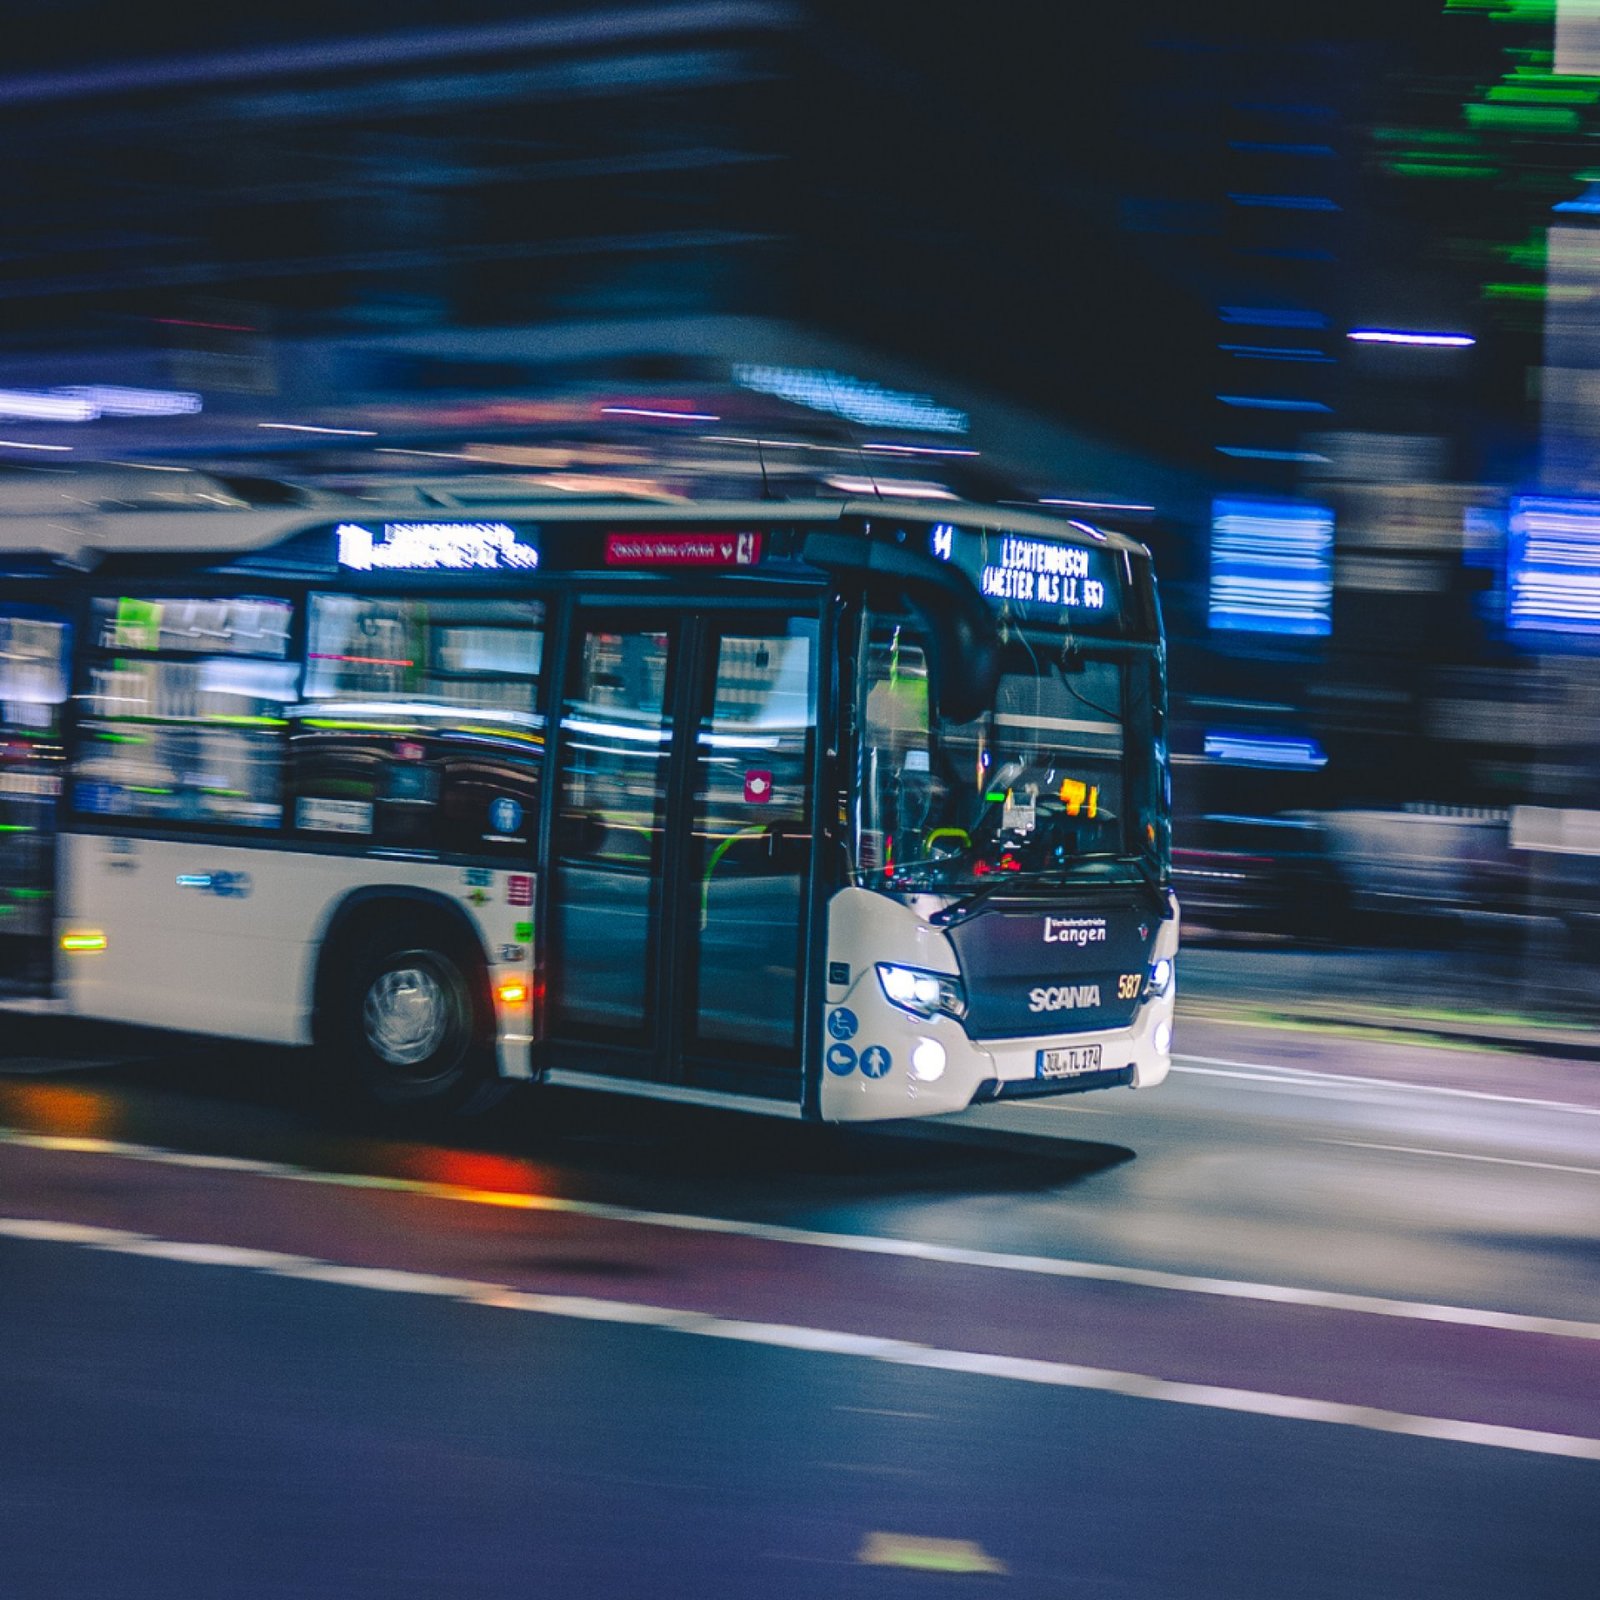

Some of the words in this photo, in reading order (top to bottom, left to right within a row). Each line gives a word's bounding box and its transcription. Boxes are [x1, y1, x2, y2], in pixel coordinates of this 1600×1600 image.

[1044, 916, 1106, 947] Langen
[1028, 985, 1101, 1012] SCANIA
[1117, 974, 1142, 999] 587
